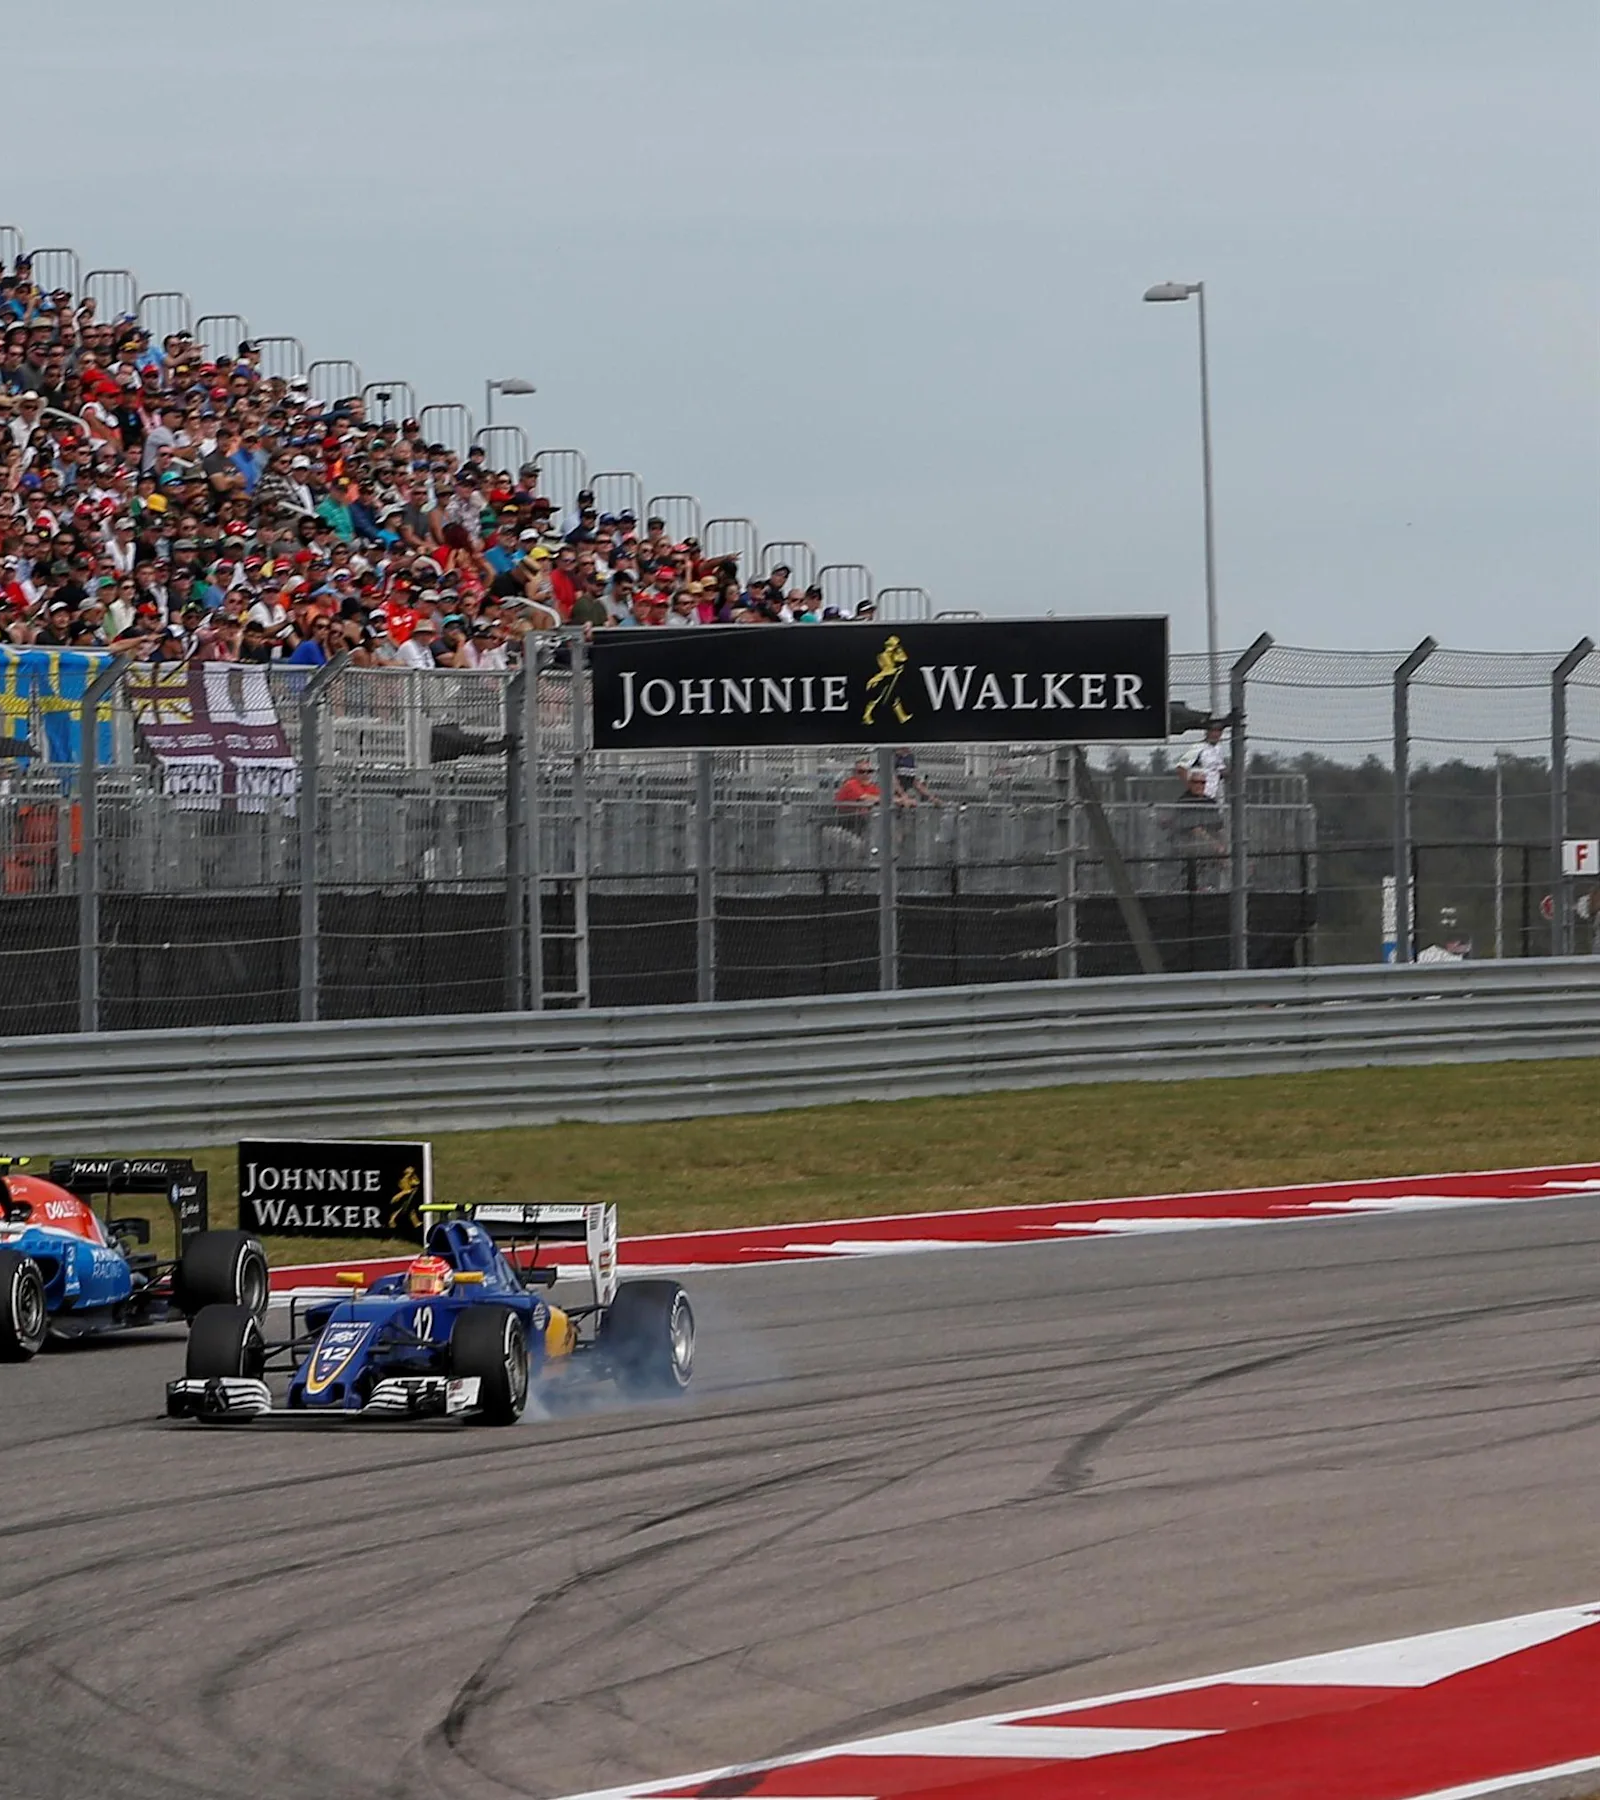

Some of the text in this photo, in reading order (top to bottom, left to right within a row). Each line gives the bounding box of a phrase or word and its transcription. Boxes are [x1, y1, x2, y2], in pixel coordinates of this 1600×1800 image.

[612, 665, 1145, 729] JOHNNIE WALKER
[1575, 844, 1589, 872] F
[241, 1162, 382, 1197] JOHNNIE
[252, 1199, 382, 1228] WALKER
[413, 1305, 434, 1342] 12
[319, 1346, 352, 1361] 12
